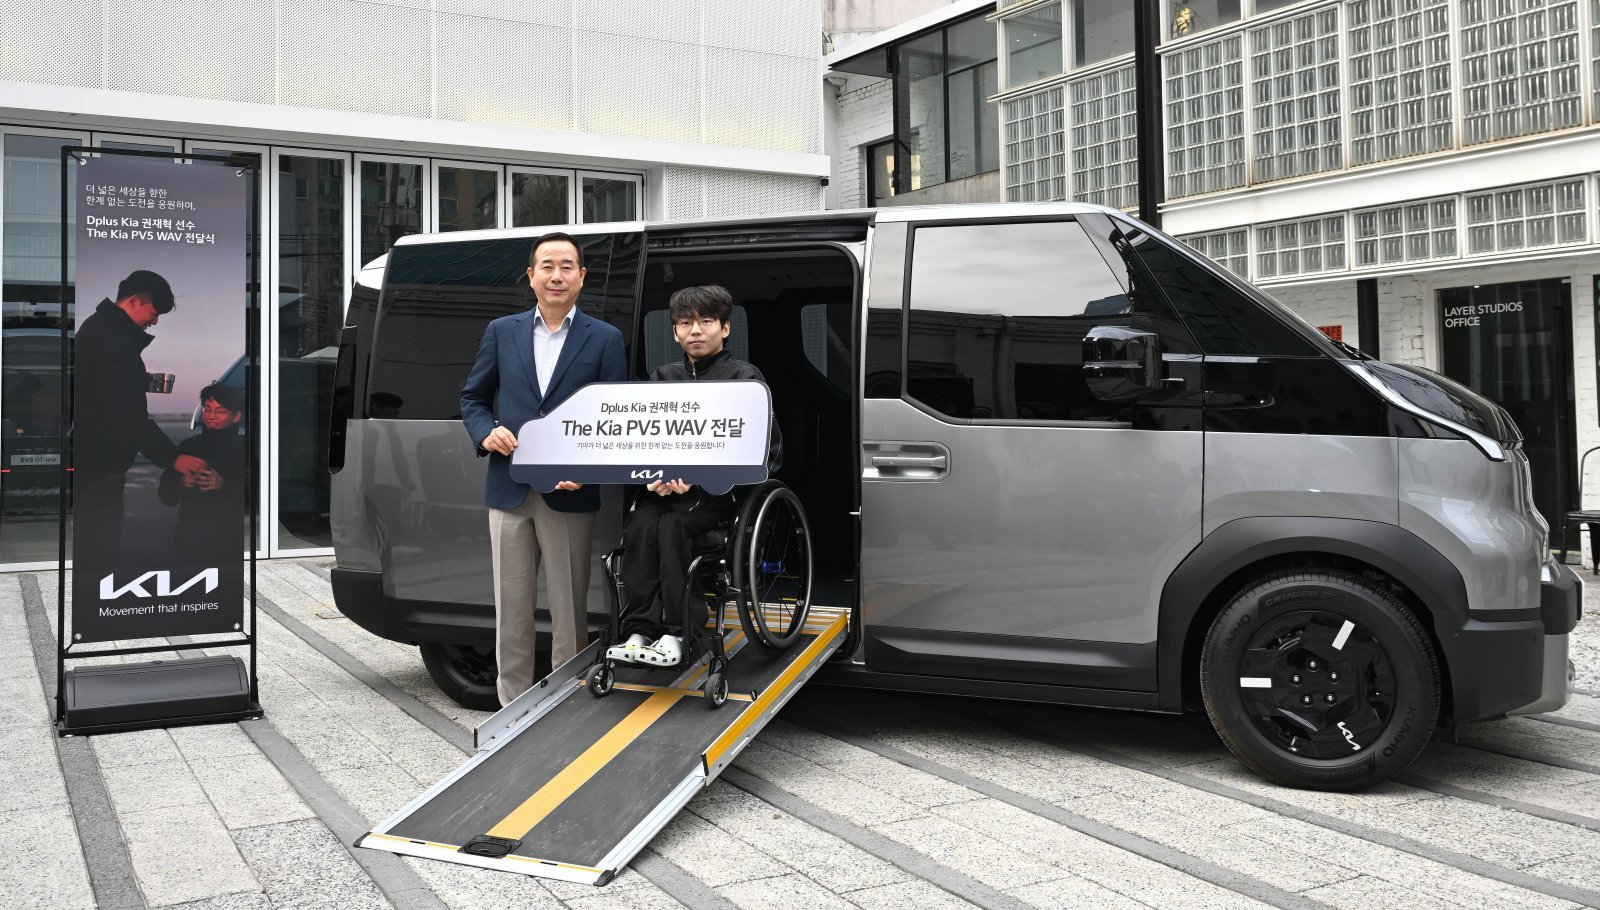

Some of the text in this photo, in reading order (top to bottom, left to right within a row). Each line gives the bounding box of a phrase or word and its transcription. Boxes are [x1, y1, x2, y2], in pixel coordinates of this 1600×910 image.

[86, 184, 167, 198] 더 넓은 세상을 향한
[86, 195, 196, 210] 한계 없는 도전을 응원하며,
[86, 215, 195, 231] Dplus Kia 권재혁 선수
[86, 228, 215, 244] The Kia PV5 WAV 전달식
[1444, 301, 1523, 317] LAYER STUDIOS
[1444, 316, 1481, 328] OFFICE
[601, 401, 700, 415] Dplus Kia 권재혁 선수
[562, 418, 745, 438] The Kia PV5 WAV 전달
[631, 469, 664, 479] KIA
[100, 567, 219, 600] KIA
[99, 601, 219, 617] Movement that inspires
[1383, 707, 1417, 757] KUMHO
